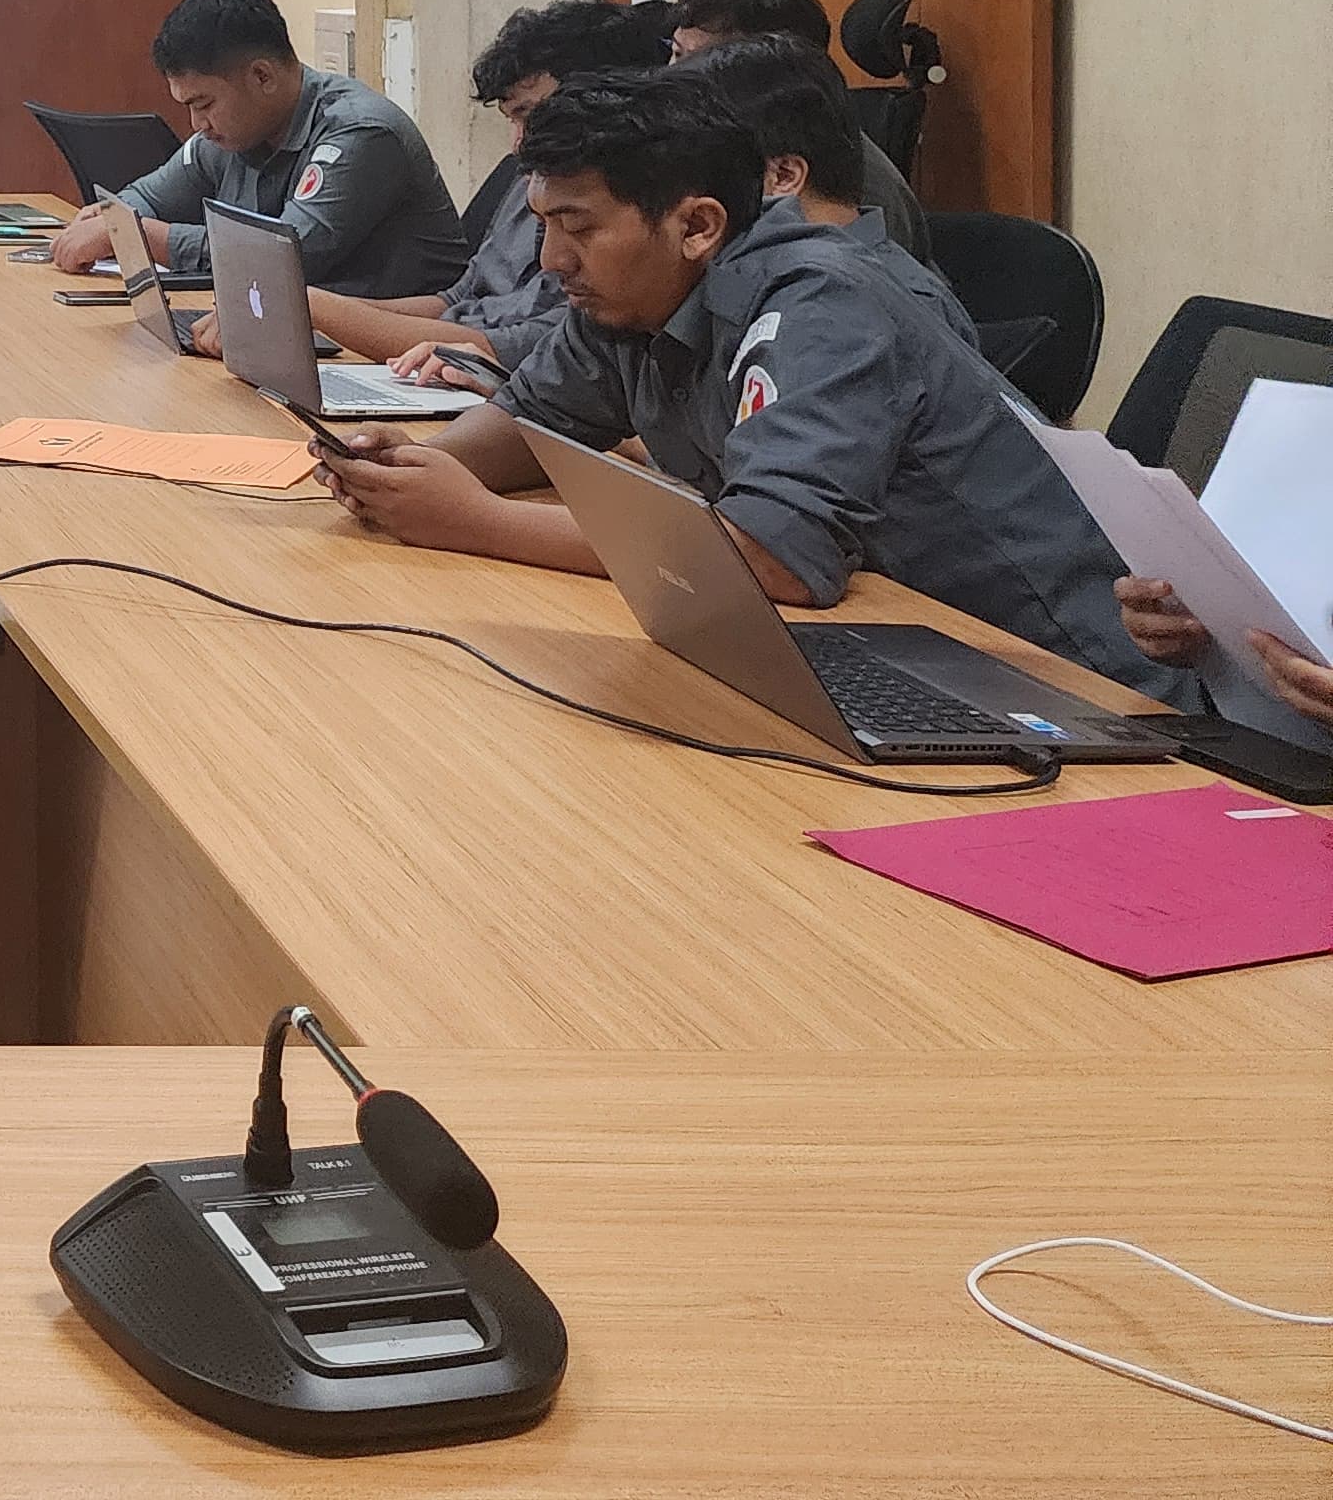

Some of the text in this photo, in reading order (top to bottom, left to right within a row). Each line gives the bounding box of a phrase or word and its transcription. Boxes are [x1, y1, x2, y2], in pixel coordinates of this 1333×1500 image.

[274, 1193, 307, 1205] UHF
[272, 1251, 416, 1272] PROFESSIONAL WIRELESS
[277, 1261, 429, 1284] CONFERENCE MICROPHONE
